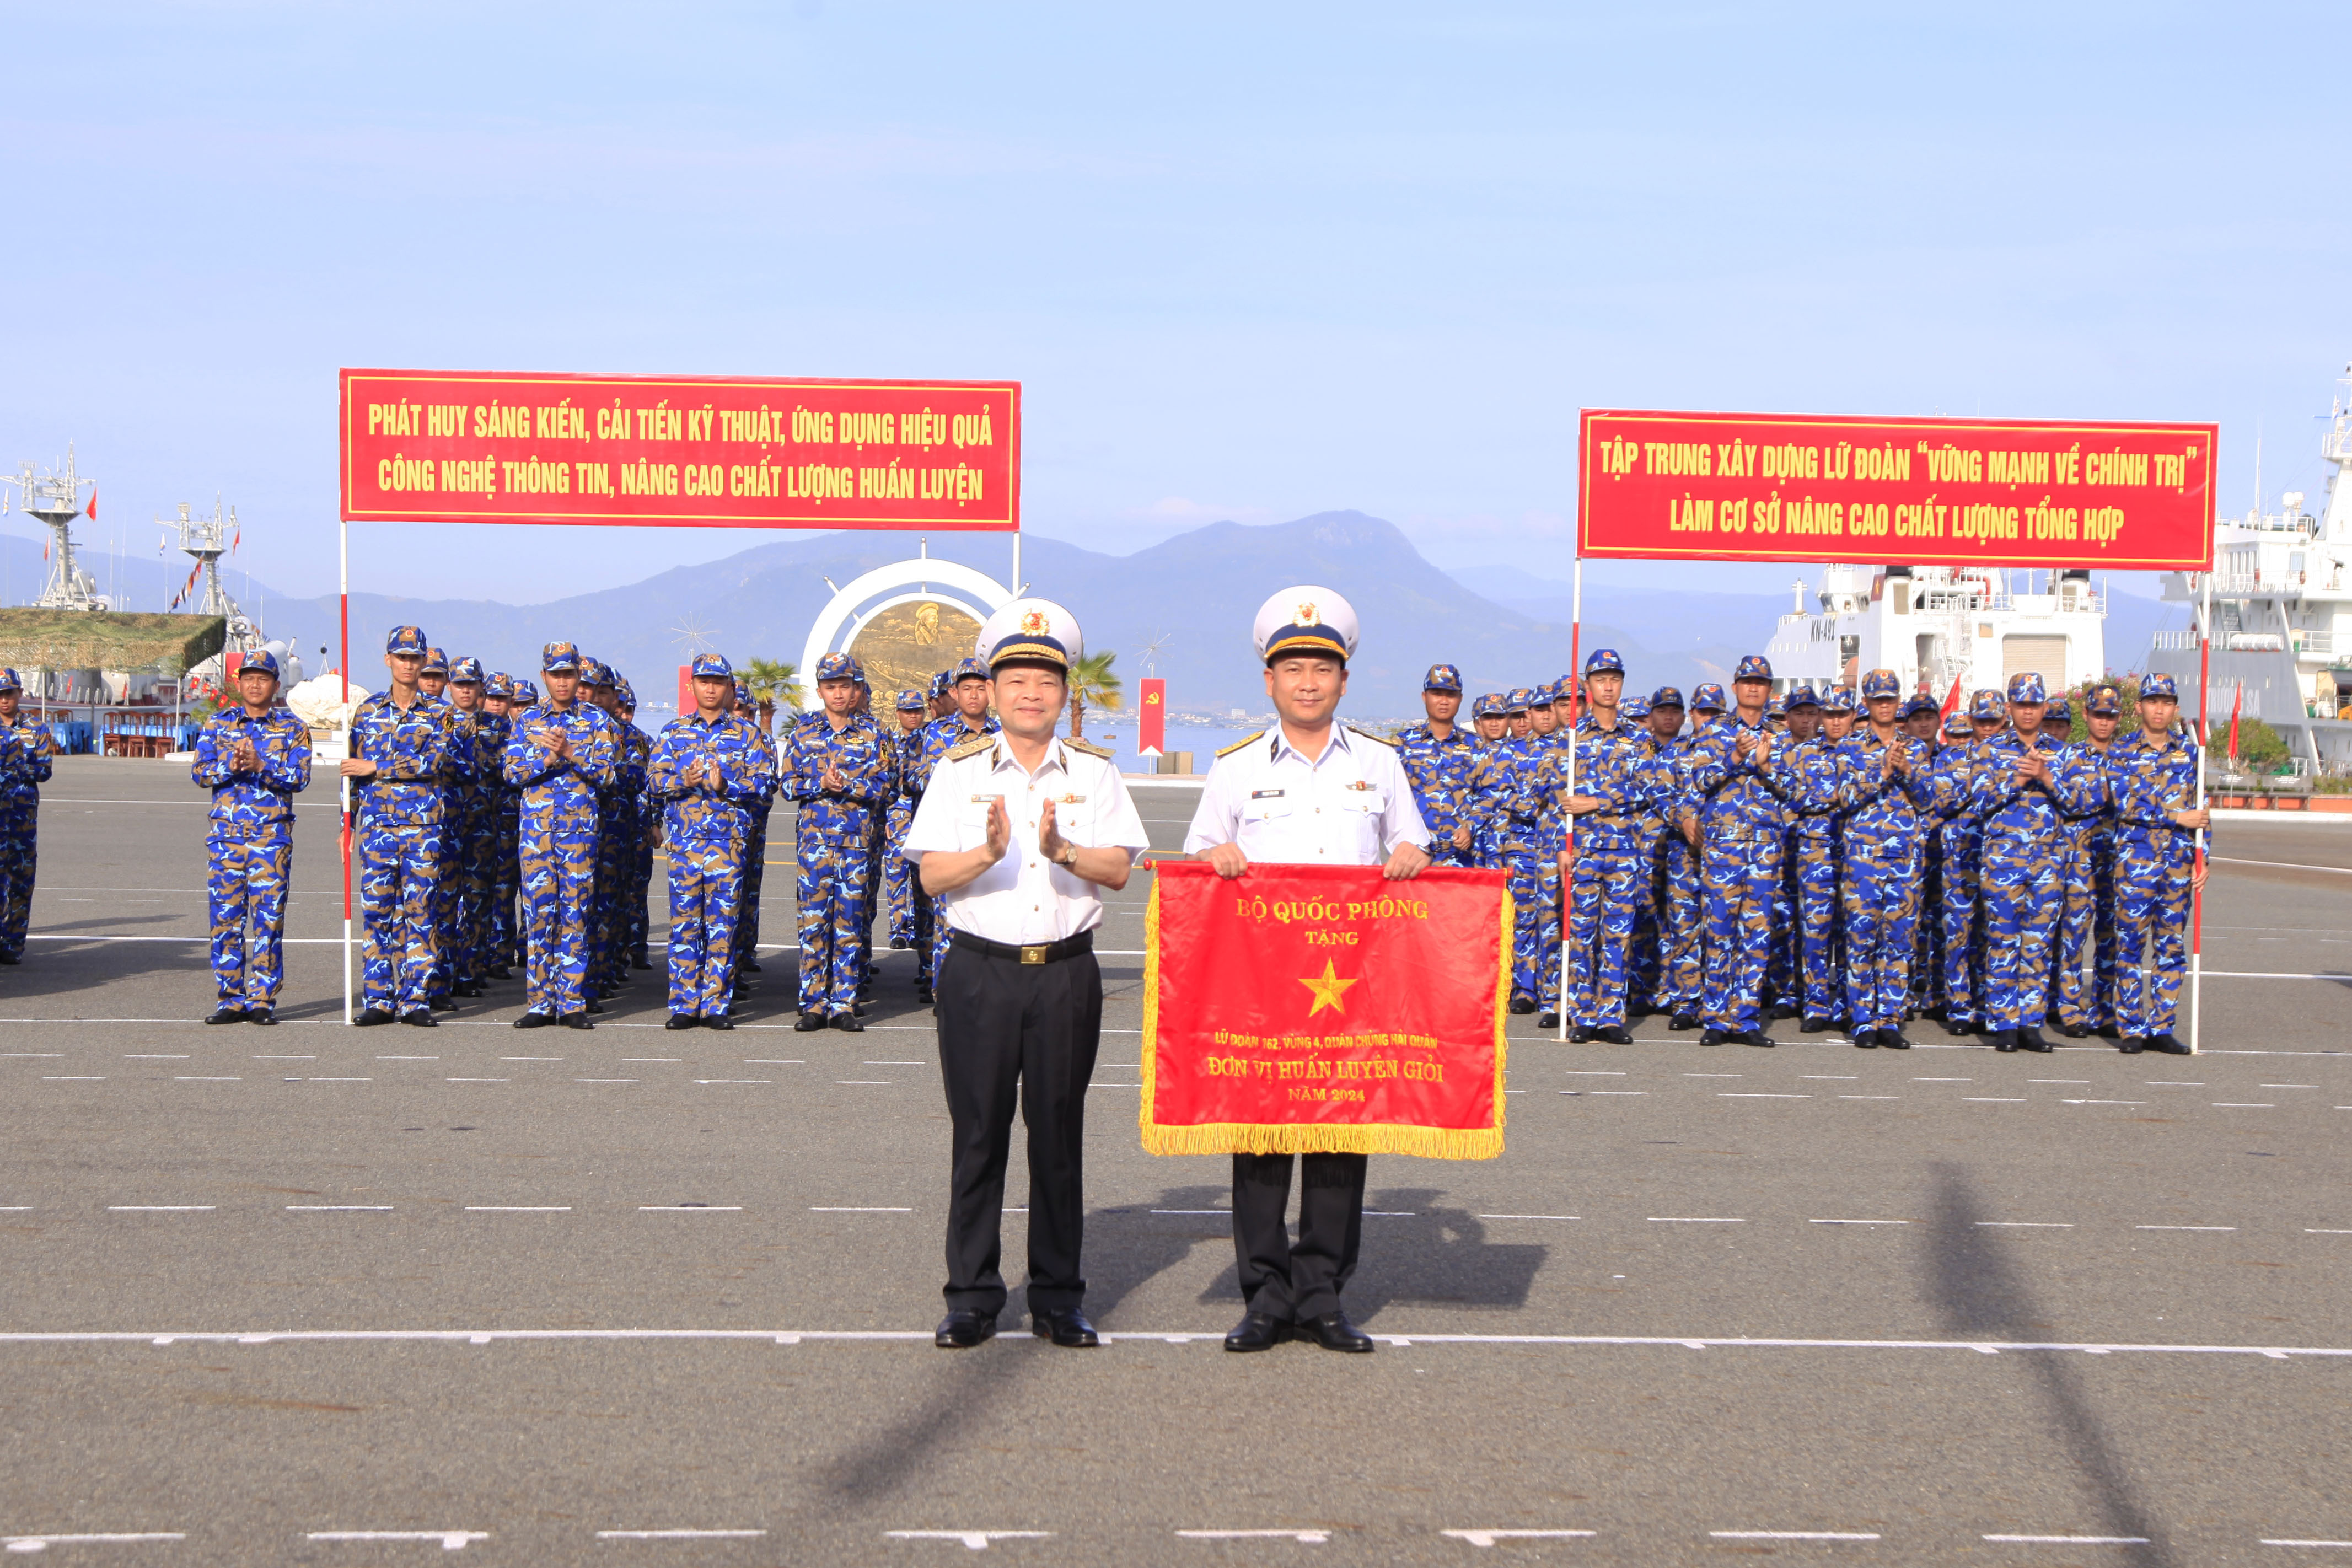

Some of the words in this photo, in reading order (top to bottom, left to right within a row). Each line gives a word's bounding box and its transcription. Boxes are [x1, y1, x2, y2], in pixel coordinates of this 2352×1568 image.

[368, 398, 421, 436] PHÁT
[428, 405, 468, 437] HUY
[474, 399, 530, 438] SÁNG
[537, 398, 590, 443] KIẾN,
[597, 398, 631, 440] CẢI
[637, 399, 682, 441] TIẾN
[689, 404, 715, 442] KỸ
[720, 405, 786, 449] THUẬT,
[792, 405, 834, 443] ỨNG
[840, 412, 895, 451] DỤNG
[901, 407, 947, 452] HIỆU
[953, 404, 993, 449] QUẢ
[1601, 435, 1639, 480] TẬP
[1645, 442, 1711, 476] TRUNG
[1716, 438, 1758, 477] XÂY
[1763, 443, 1818, 485] DỰNG
[1824, 441, 1851, 480] LỮ
[1918, 441, 1983, 482] “VỮNG
[1988, 450, 2049, 490] MẠNH
[2055, 442, 2079, 484] VỀ
[2086, 447, 2149, 486] CHÍNH
[2154, 446, 2198, 493] TRỊ”
[378, 453, 434, 491] CÔNG
[442, 454, 496, 499] NGHỆ
[502, 455, 570, 493] THÔNG
[576, 463, 615, 498] TIN,
[621, 458, 678, 496] NÂNG
[685, 464, 724, 496] CAO
[731, 455, 782, 497] CHẤT
[788, 464, 853, 505] LƯỢNG
[860, 457, 914, 500] HUẤN
[921, 462, 983, 507] LUYỆN
[1670, 492, 1714, 531] LÀM
[1720, 497, 1748, 533] CƠ
[1753, 491, 1781, 534] SỞ
[1786, 495, 1843, 535] NÂNG
[1849, 503, 1889, 536] CAO
[1895, 494, 1947, 537] CHẤT
[1952, 503, 2019, 545] LƯỢNG
[2025, 495, 2077, 540] TỔNG
[2083, 506, 2125, 547] HỢP
[1811, 617, 1835, 642] KN-491
[2246, 688, 2260, 715] SA
[1237, 895, 1268, 923] BỘ
[1273, 895, 1340, 924] QUỐC
[1346, 894, 1429, 920] PHÒNG
[1304, 928, 1360, 947] TẶNG
[1207, 1055, 1248, 1078] ĐƠN
[1252, 1060, 1273, 1084] VỊ
[1277, 1052, 1332, 1080] HUẤN
[1335, 1054, 1399, 1083] LUYỆN
[1403, 1054, 1444, 1082] GIỎI
[1288, 1085, 1326, 1101] NĂM
[1331, 1088, 1366, 1102] 2024
